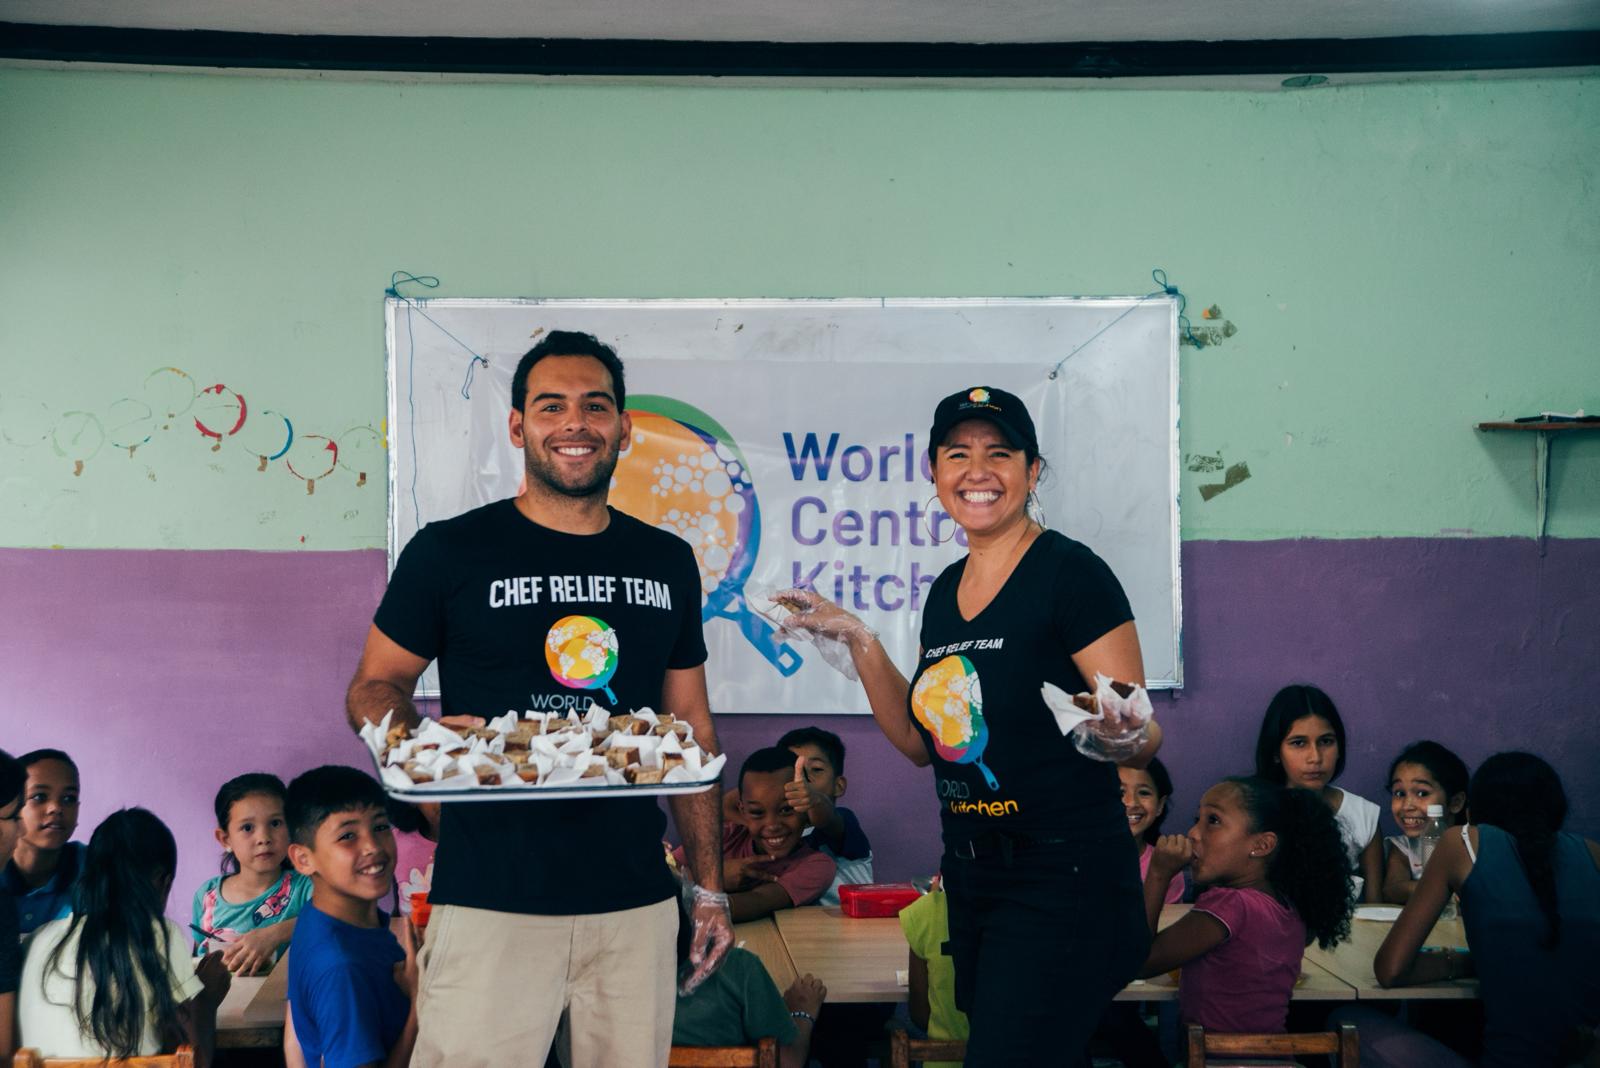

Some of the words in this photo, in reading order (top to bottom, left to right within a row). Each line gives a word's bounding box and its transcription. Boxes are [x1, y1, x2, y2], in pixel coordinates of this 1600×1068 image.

[791, 496, 969, 546] Centr
[489, 577, 543, 608] CHEF
[549, 575, 616, 603] RELIEF
[622, 577, 672, 611] TEAM
[792, 560, 937, 611] Kitch
[925, 645, 947, 659] CHEF
[946, 640, 974, 656] RELIEF
[974, 638, 1004, 650] TEAM
[531, 693, 595, 711] WORLD
[940, 779, 970, 799] ORLD
